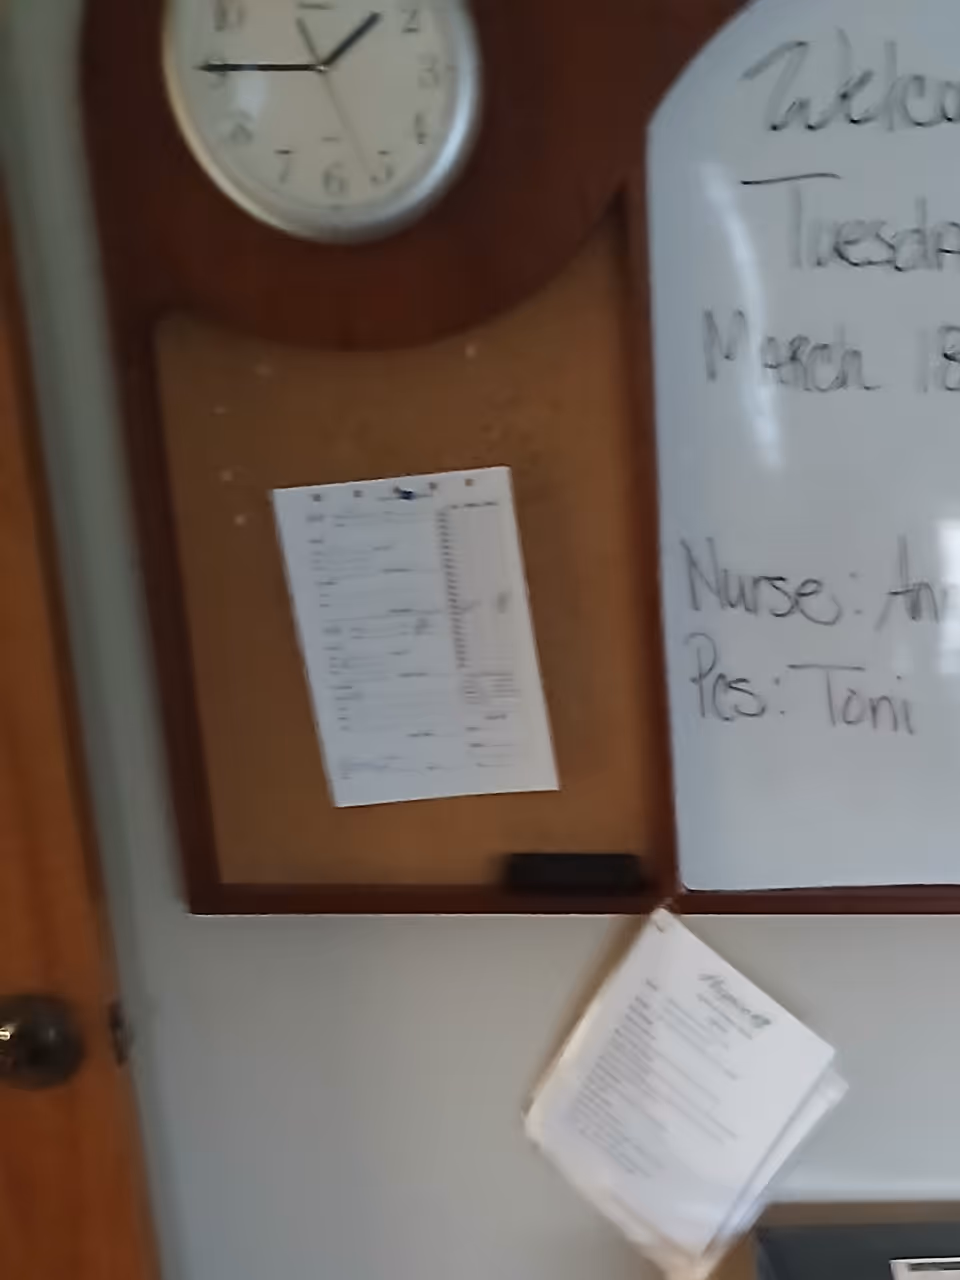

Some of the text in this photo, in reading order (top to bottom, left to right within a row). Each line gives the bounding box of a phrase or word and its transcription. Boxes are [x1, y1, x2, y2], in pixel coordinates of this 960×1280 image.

[403, 7, 421, 34] 2
[322, 160, 348, 198] 6
[680, 536, 864, 626] Nurse:
[787, 662, 916, 736] Toni
